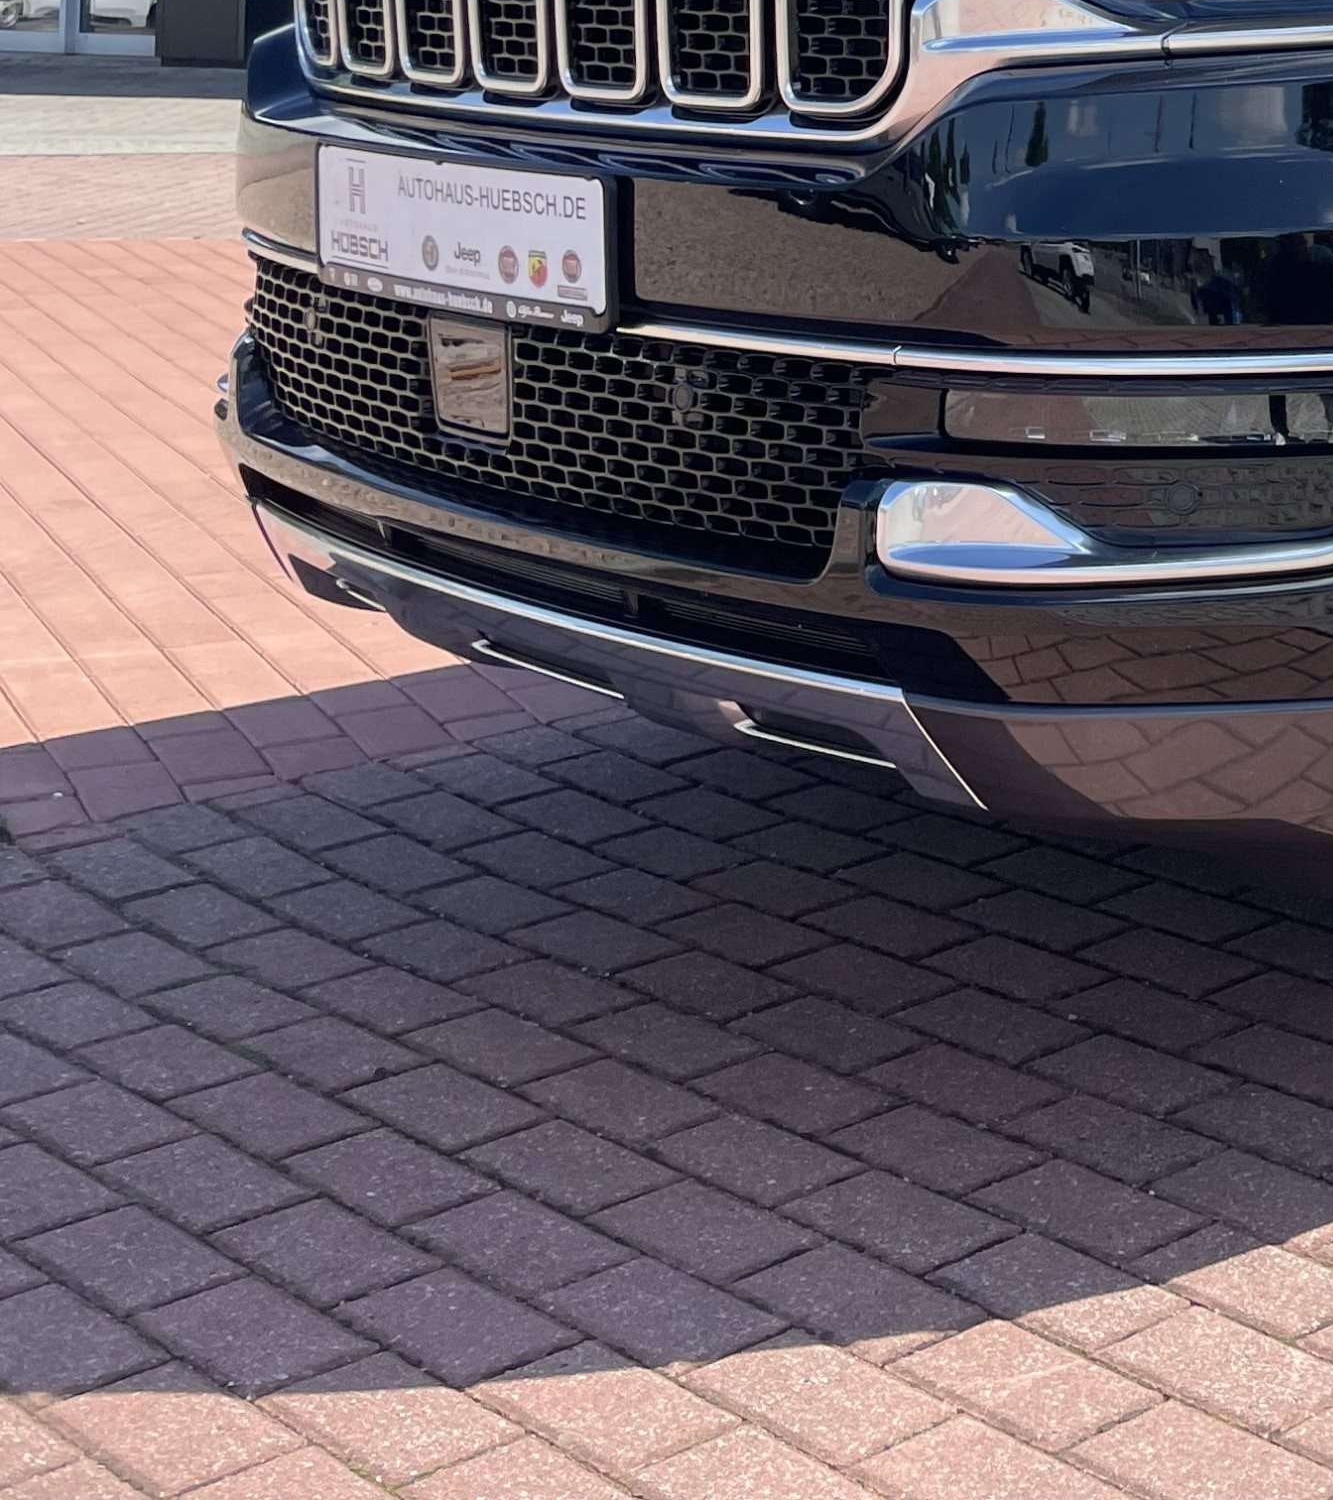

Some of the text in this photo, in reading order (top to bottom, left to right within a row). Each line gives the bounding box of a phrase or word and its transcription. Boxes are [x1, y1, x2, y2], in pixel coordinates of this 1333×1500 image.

[397, 175, 588, 221] AUTOHAUS-HUEBSCH.DE
[453, 242, 481, 266] Jeep
[560, 308, 584, 327] Jeep
